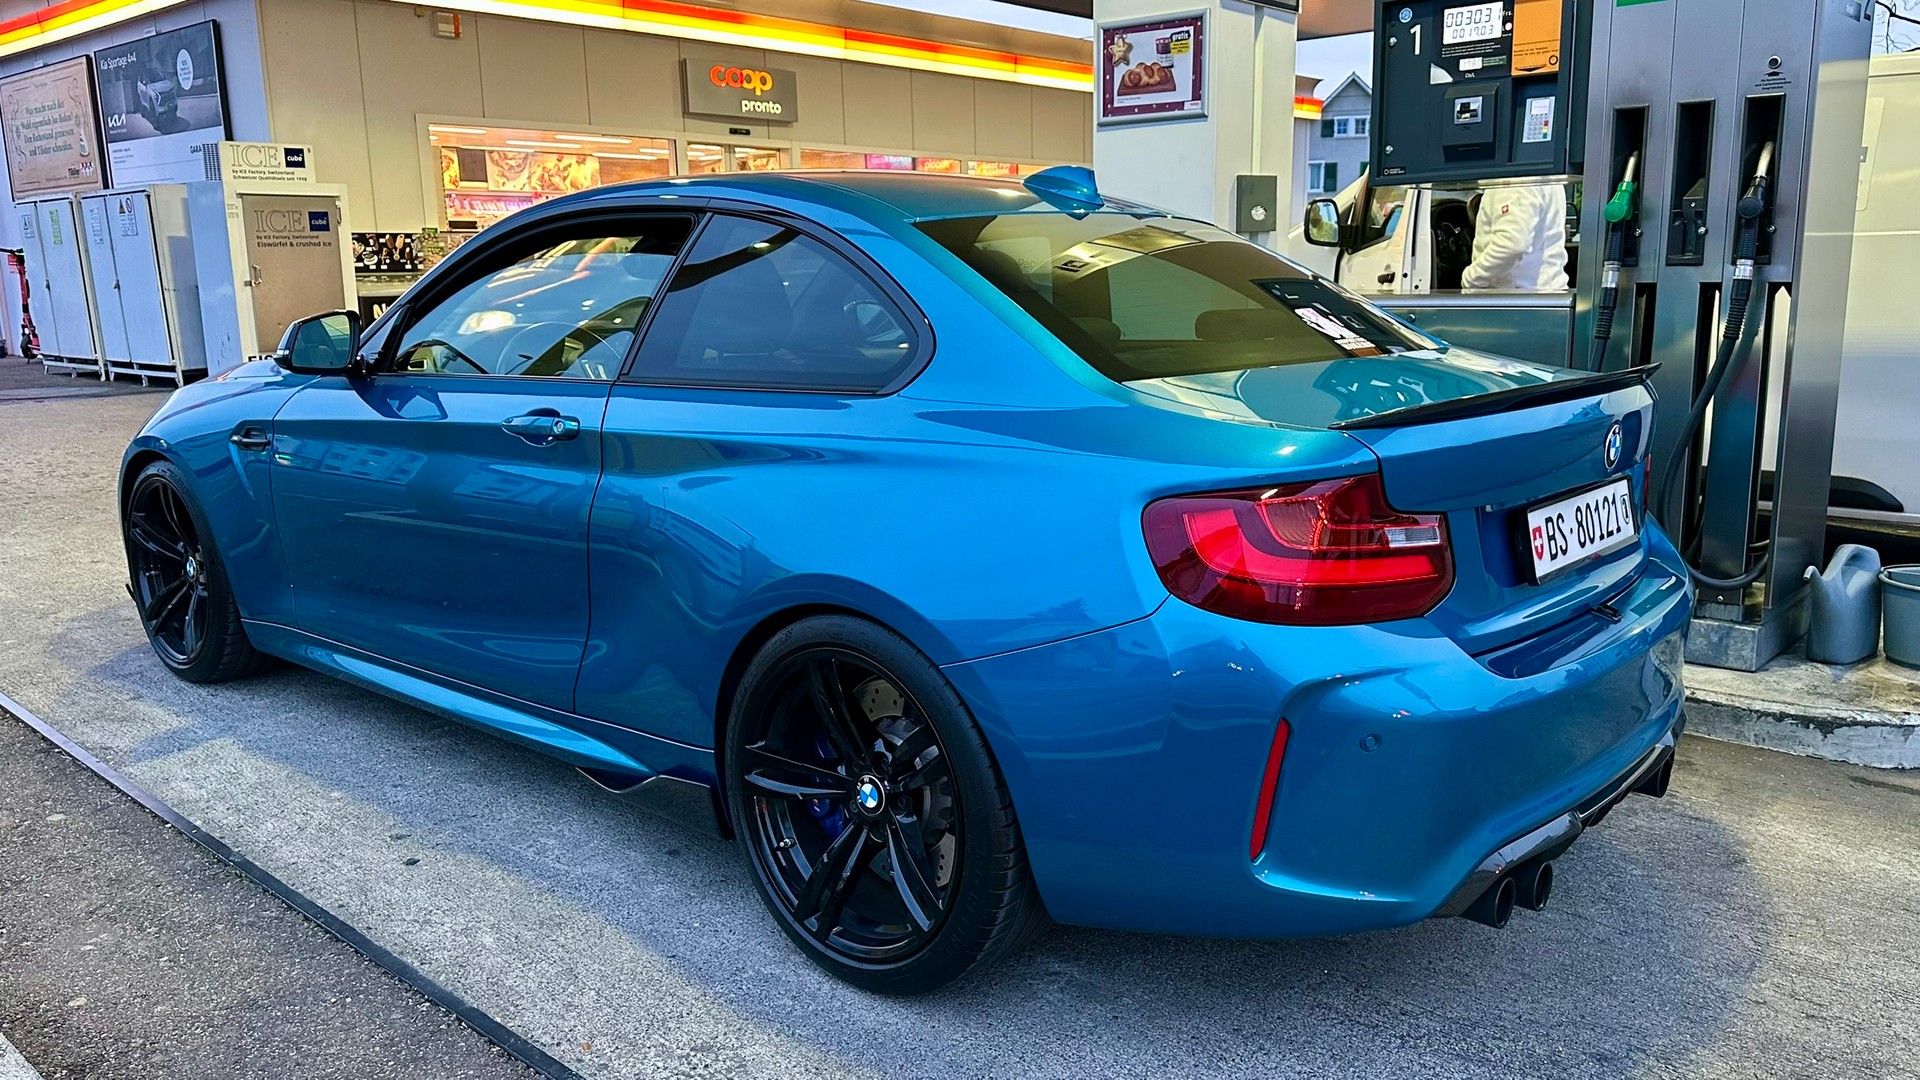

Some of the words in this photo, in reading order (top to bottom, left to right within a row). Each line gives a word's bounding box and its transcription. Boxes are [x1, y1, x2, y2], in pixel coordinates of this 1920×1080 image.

[1172, 32, 1189, 42] gratis
[1410, 24, 1421, 55] 1
[108, 54, 127, 70] Sportage
[128, 52, 136, 62] 4x4
[709, 64, 774, 96] coop
[741, 100, 782, 114] pronto
[230, 144, 281, 168] ICE
[254, 210, 306, 233] ICE
[311, 217, 327, 225] cube
